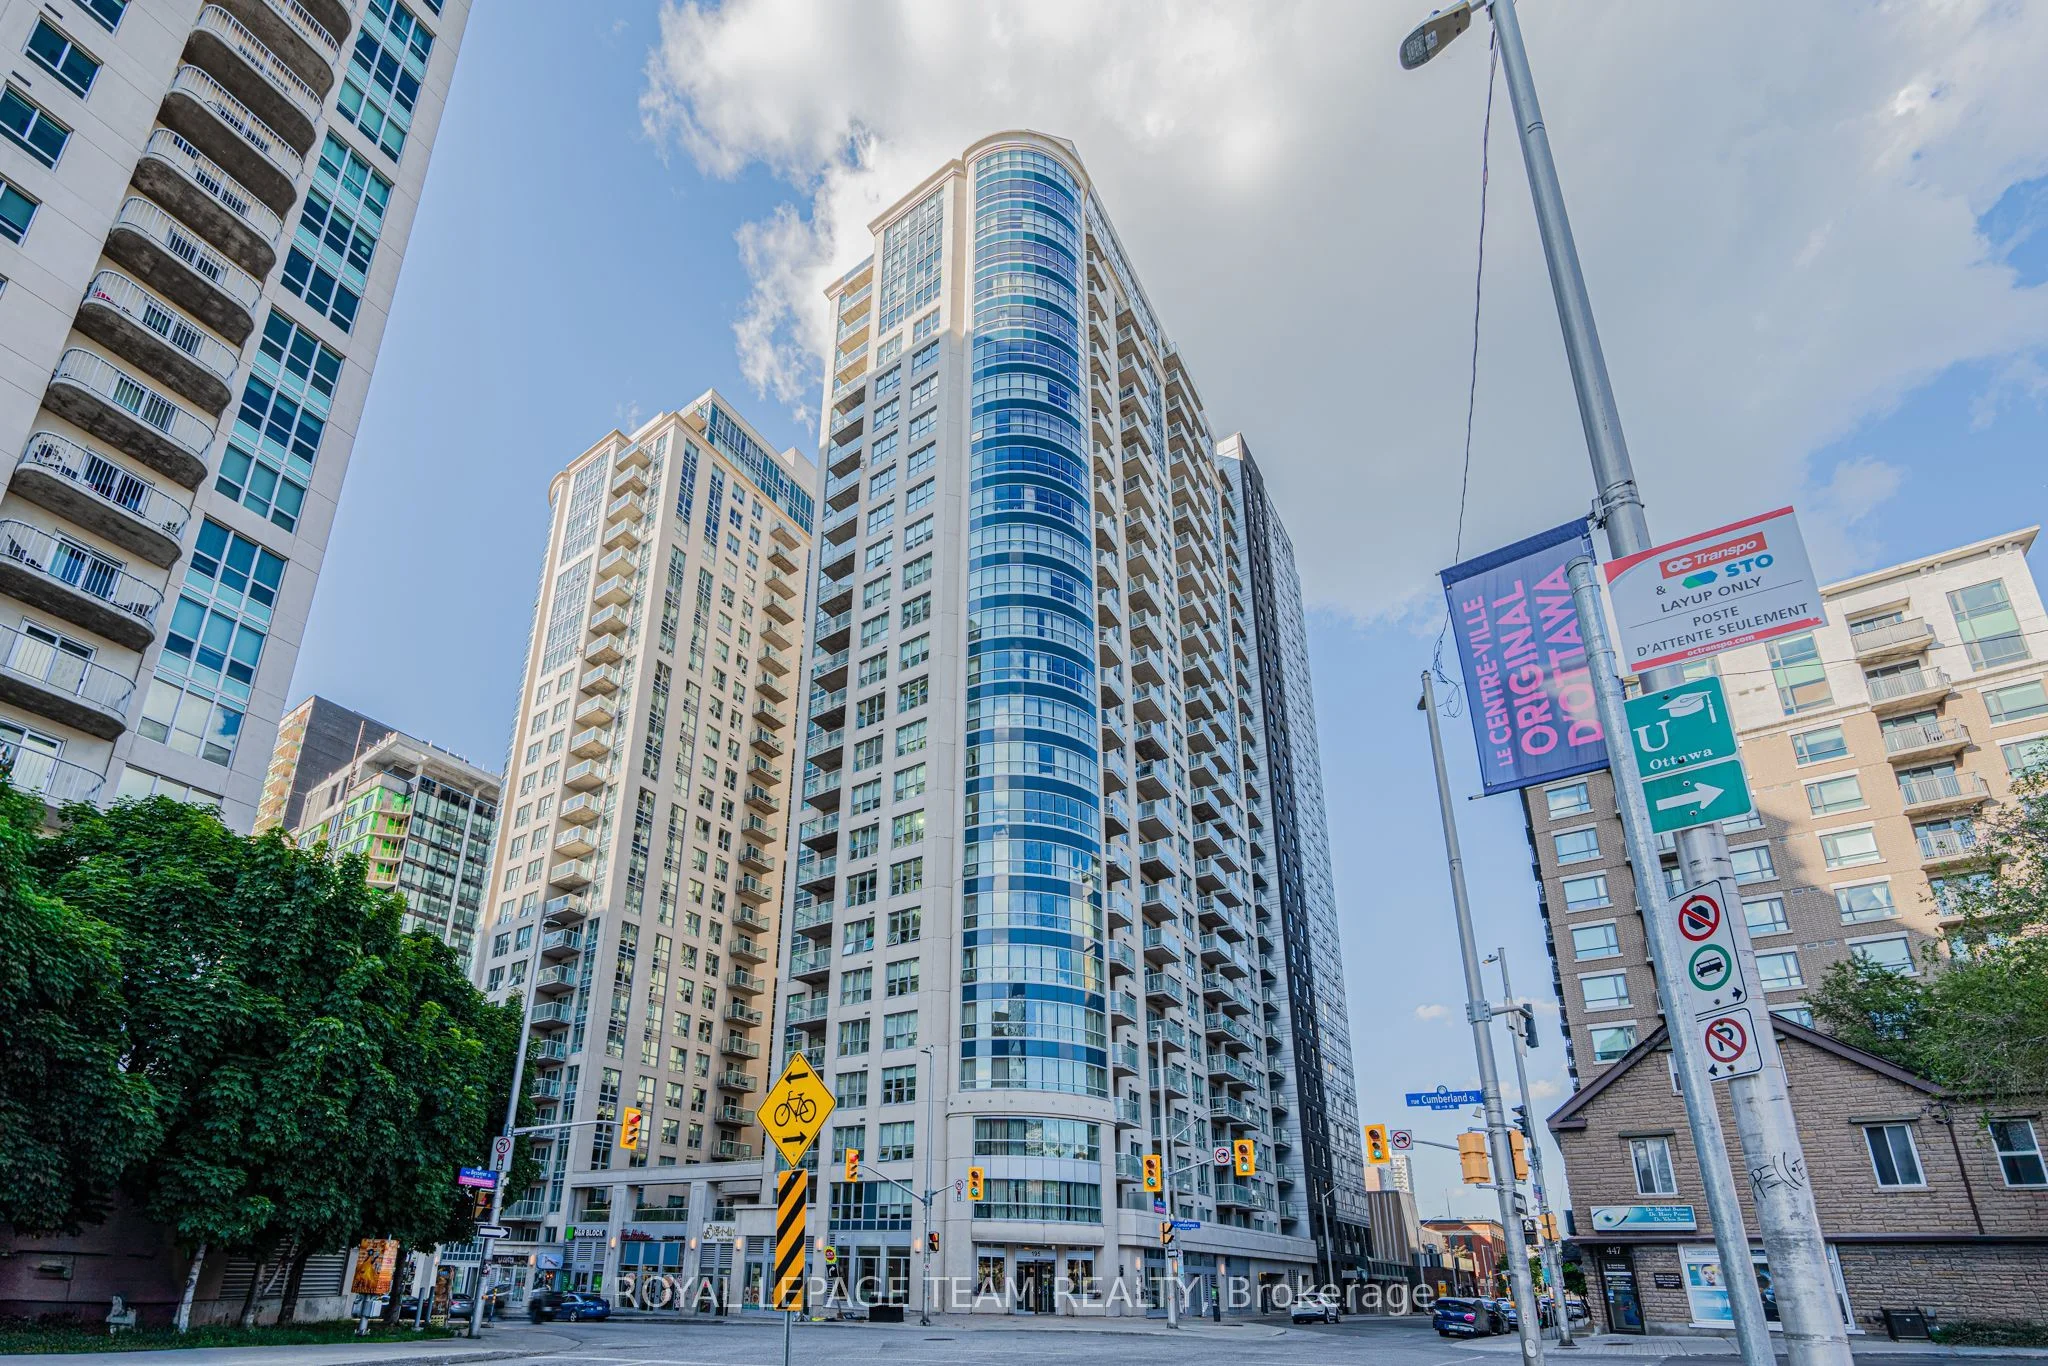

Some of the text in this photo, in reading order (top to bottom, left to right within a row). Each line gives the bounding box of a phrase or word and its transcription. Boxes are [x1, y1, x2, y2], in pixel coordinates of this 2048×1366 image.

[1666, 540, 1757, 573] OC Transpo
[1725, 553, 1774, 577] STO
[1655, 585, 1666, 596] &
[1661, 576, 1762, 613] LAYUP ONLY
[1692, 606, 1739, 627] POSTE
[1636, 602, 1809, 657] D'ATTENTE SEULEMENT
[1533, 564, 1605, 747] D'OTTAWA
[1687, 634, 1755, 656] octranspo.com
[1492, 579, 1559, 756] ORIGINAL
[1462, 595, 1514, 767] LE CENTRE-VILLE
[1632, 719, 1670, 753] U
[1649, 748, 1713, 770] Ottawa
[1421, 1092, 1468, 1104] Cumberland
[585, 1228, 604, 1238] BLOCK
[1606, 1246, 1621, 1255] 447
